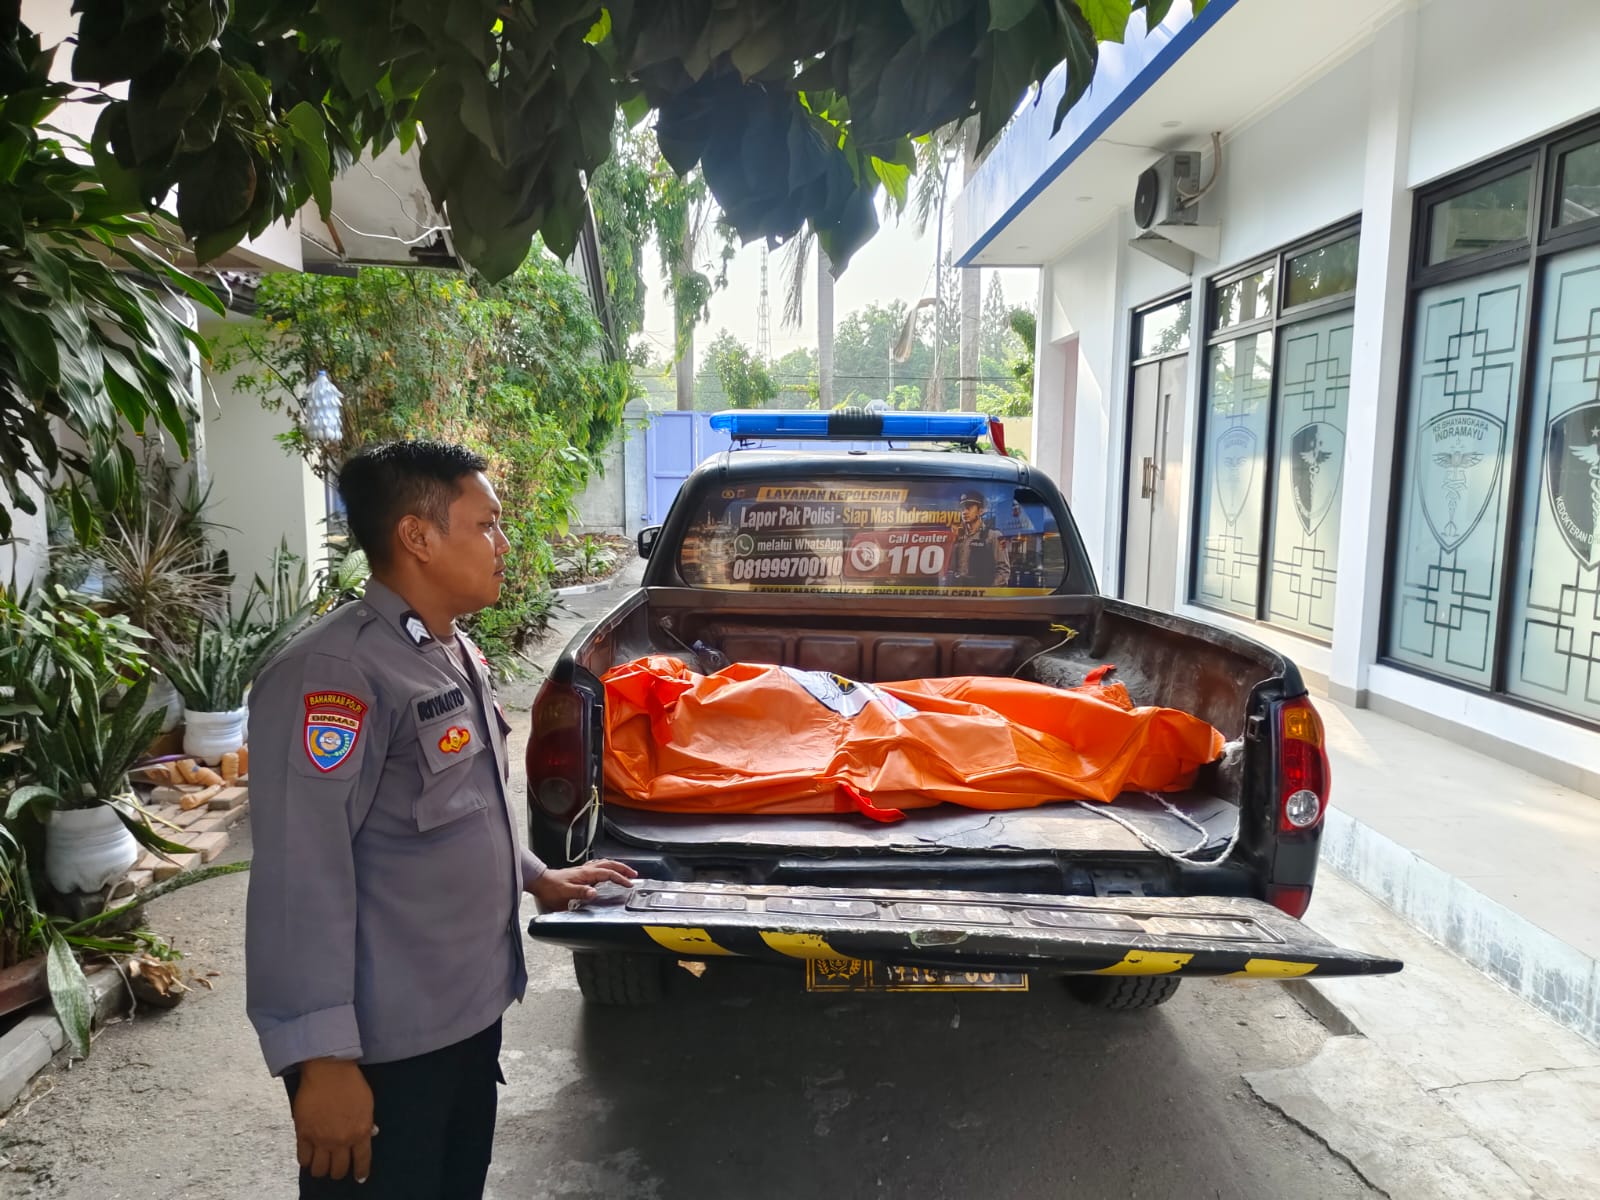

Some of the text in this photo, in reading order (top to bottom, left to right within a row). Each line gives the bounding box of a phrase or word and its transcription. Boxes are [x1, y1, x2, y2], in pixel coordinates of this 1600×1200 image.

[1441, 416, 1489, 432] BHAYANGKARA
[1434, 426, 1484, 442] INDRAMAYU
[765, 489, 900, 500] LAYANAN KEPOLISIAN
[740, 506, 777, 531] Lapor
[779, 506, 800, 526] Pak
[802, 506, 835, 525] Polisi
[843, 507, 868, 527] Siap
[871, 506, 894, 524] Mas
[896, 506, 961, 527] Indramayu
[1555, 495, 1588, 543] KEDOKTERAN
[757, 537, 843, 552] melalui WhatsApp
[889, 533, 947, 543] Call Center
[733, 556, 843, 580] 081999700110
[888, 546, 944, 575] 110
[309, 694, 346, 705] BAHARKAM
[311, 715, 356, 727] BINMAS
